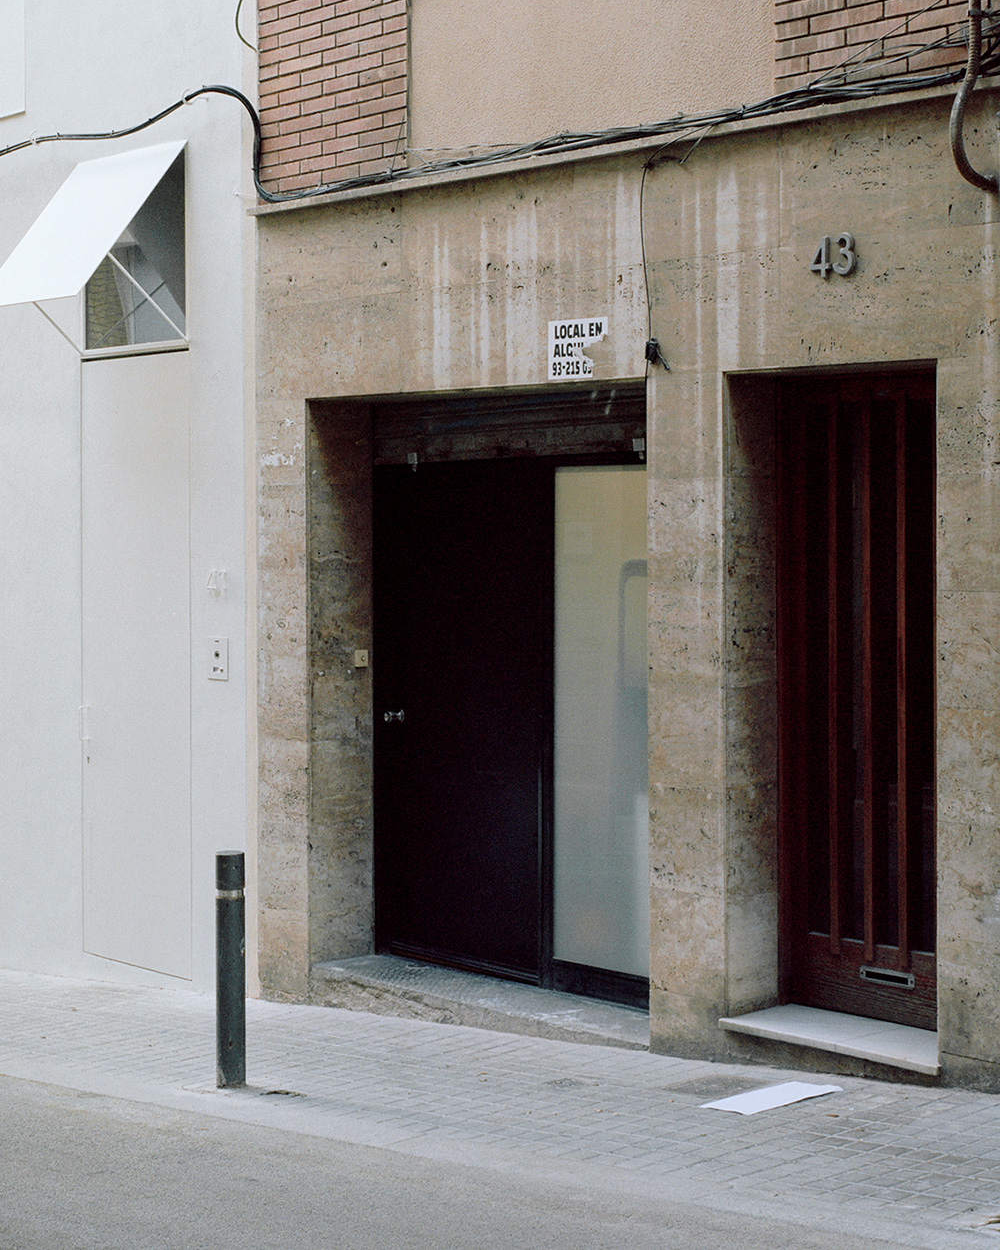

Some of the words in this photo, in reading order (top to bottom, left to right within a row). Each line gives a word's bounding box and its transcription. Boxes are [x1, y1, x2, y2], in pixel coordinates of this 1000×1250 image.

[809, 232, 855, 280] 43
[554, 323, 586, 340] LOCAL
[588, 321, 603, 337] EN
